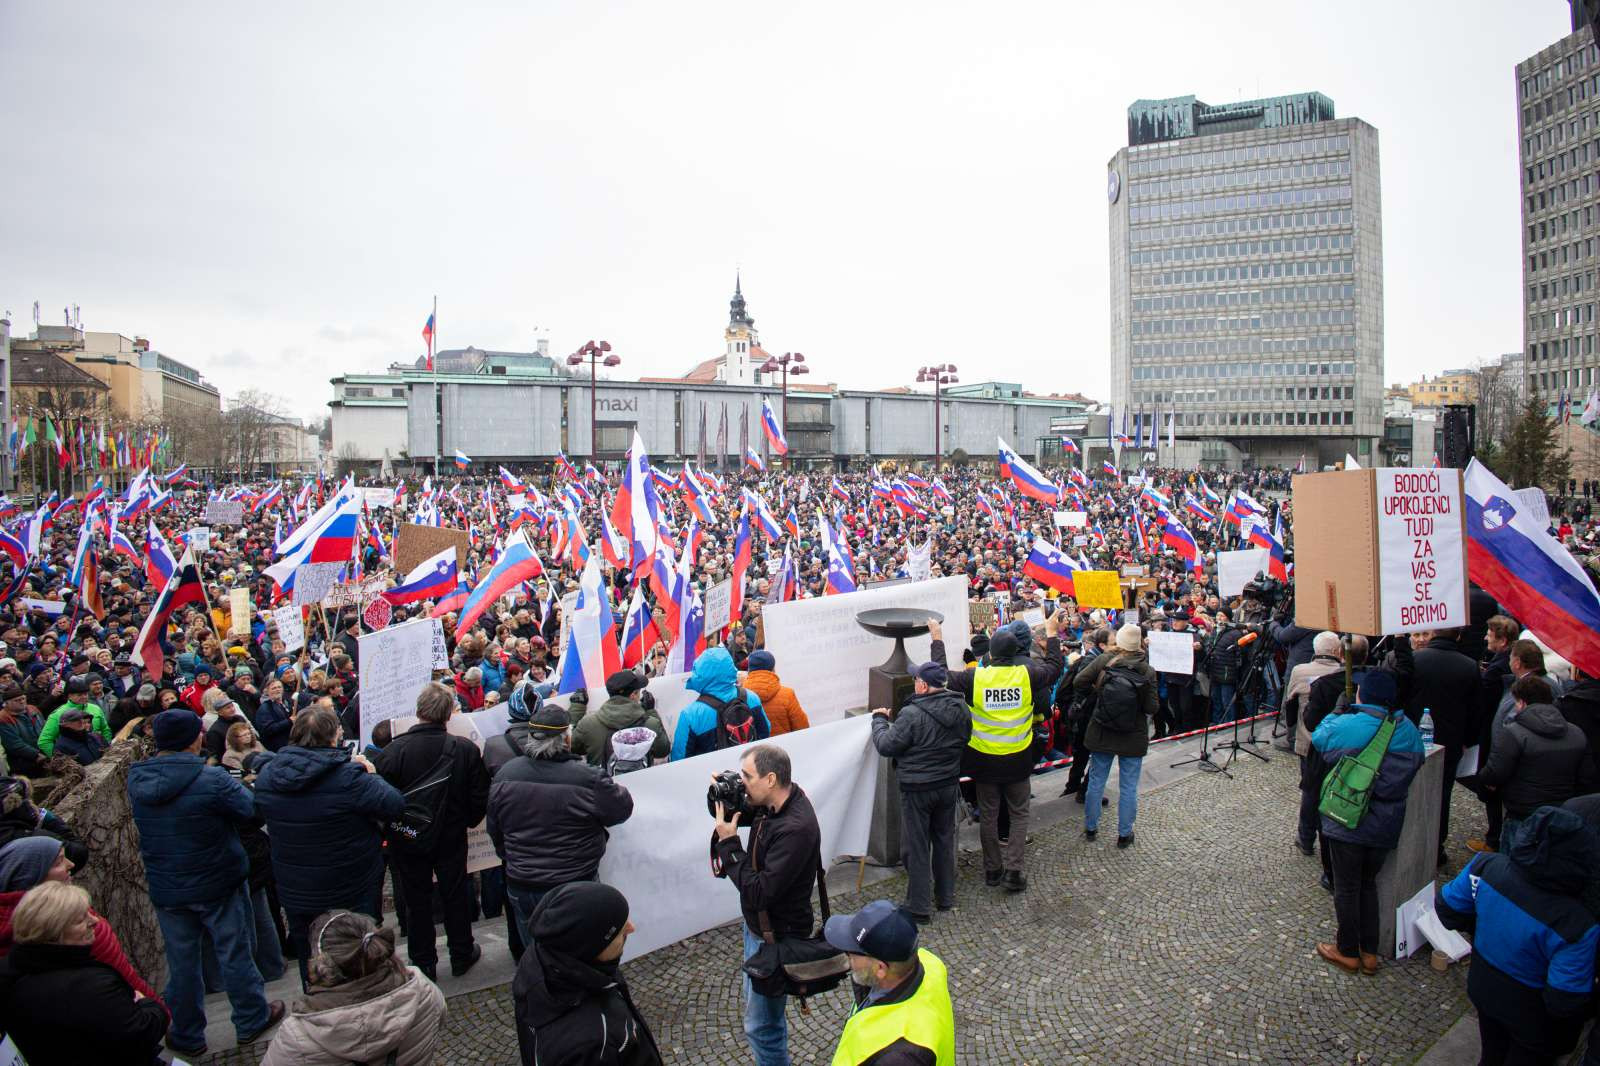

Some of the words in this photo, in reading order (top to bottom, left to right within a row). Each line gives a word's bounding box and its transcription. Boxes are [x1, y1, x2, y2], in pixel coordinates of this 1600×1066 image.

[595, 396, 638, 412] maxi
[1394, 471, 1440, 493] BODOČI
[1384, 495, 1451, 515] UPOKOJENCI
[1404, 518, 1433, 536] TUDI
[1414, 540, 1433, 558] ZA
[1411, 560, 1436, 580] VAS
[1414, 583, 1432, 601] SE
[1401, 602, 1447, 626] BORIMO
[985, 688, 1021, 702] PRESS
